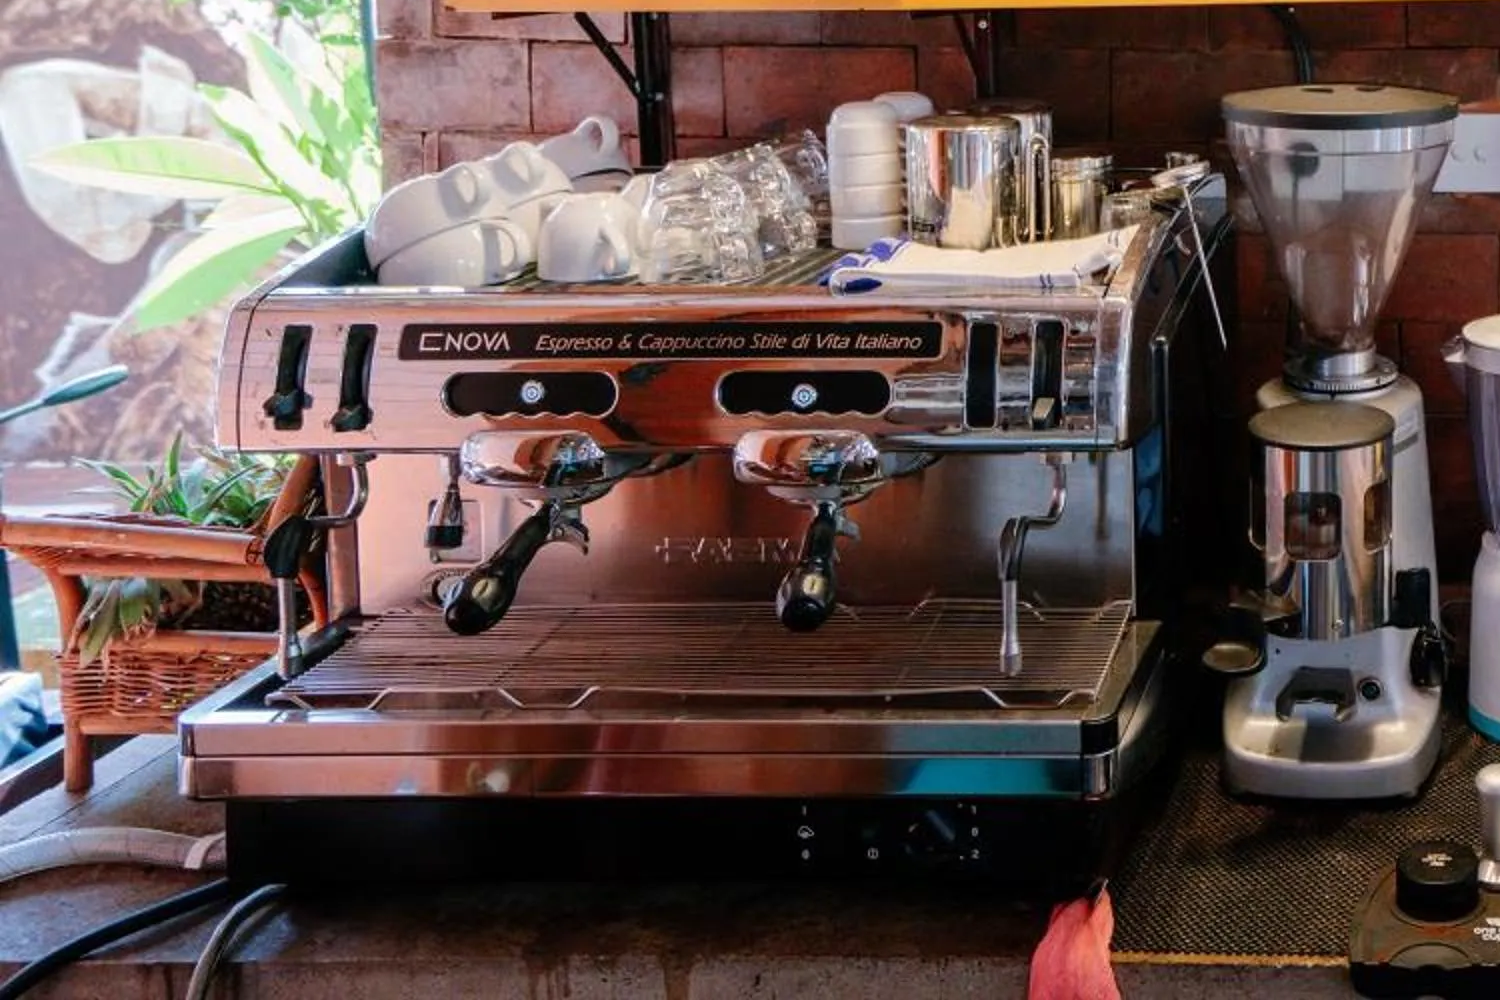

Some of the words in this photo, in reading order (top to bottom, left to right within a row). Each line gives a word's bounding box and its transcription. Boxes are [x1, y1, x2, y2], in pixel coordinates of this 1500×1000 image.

[419, 332, 510, 352] ENOVA
[535, 334, 613, 353] Espresso
[617, 334, 633, 349] &
[638, 334, 745, 352] Cappuccino
[750, 333, 787, 349] Stile
[791, 333, 810, 349] di
[815, 333, 850, 349] Vita
[855, 333, 923, 349] Italiano
